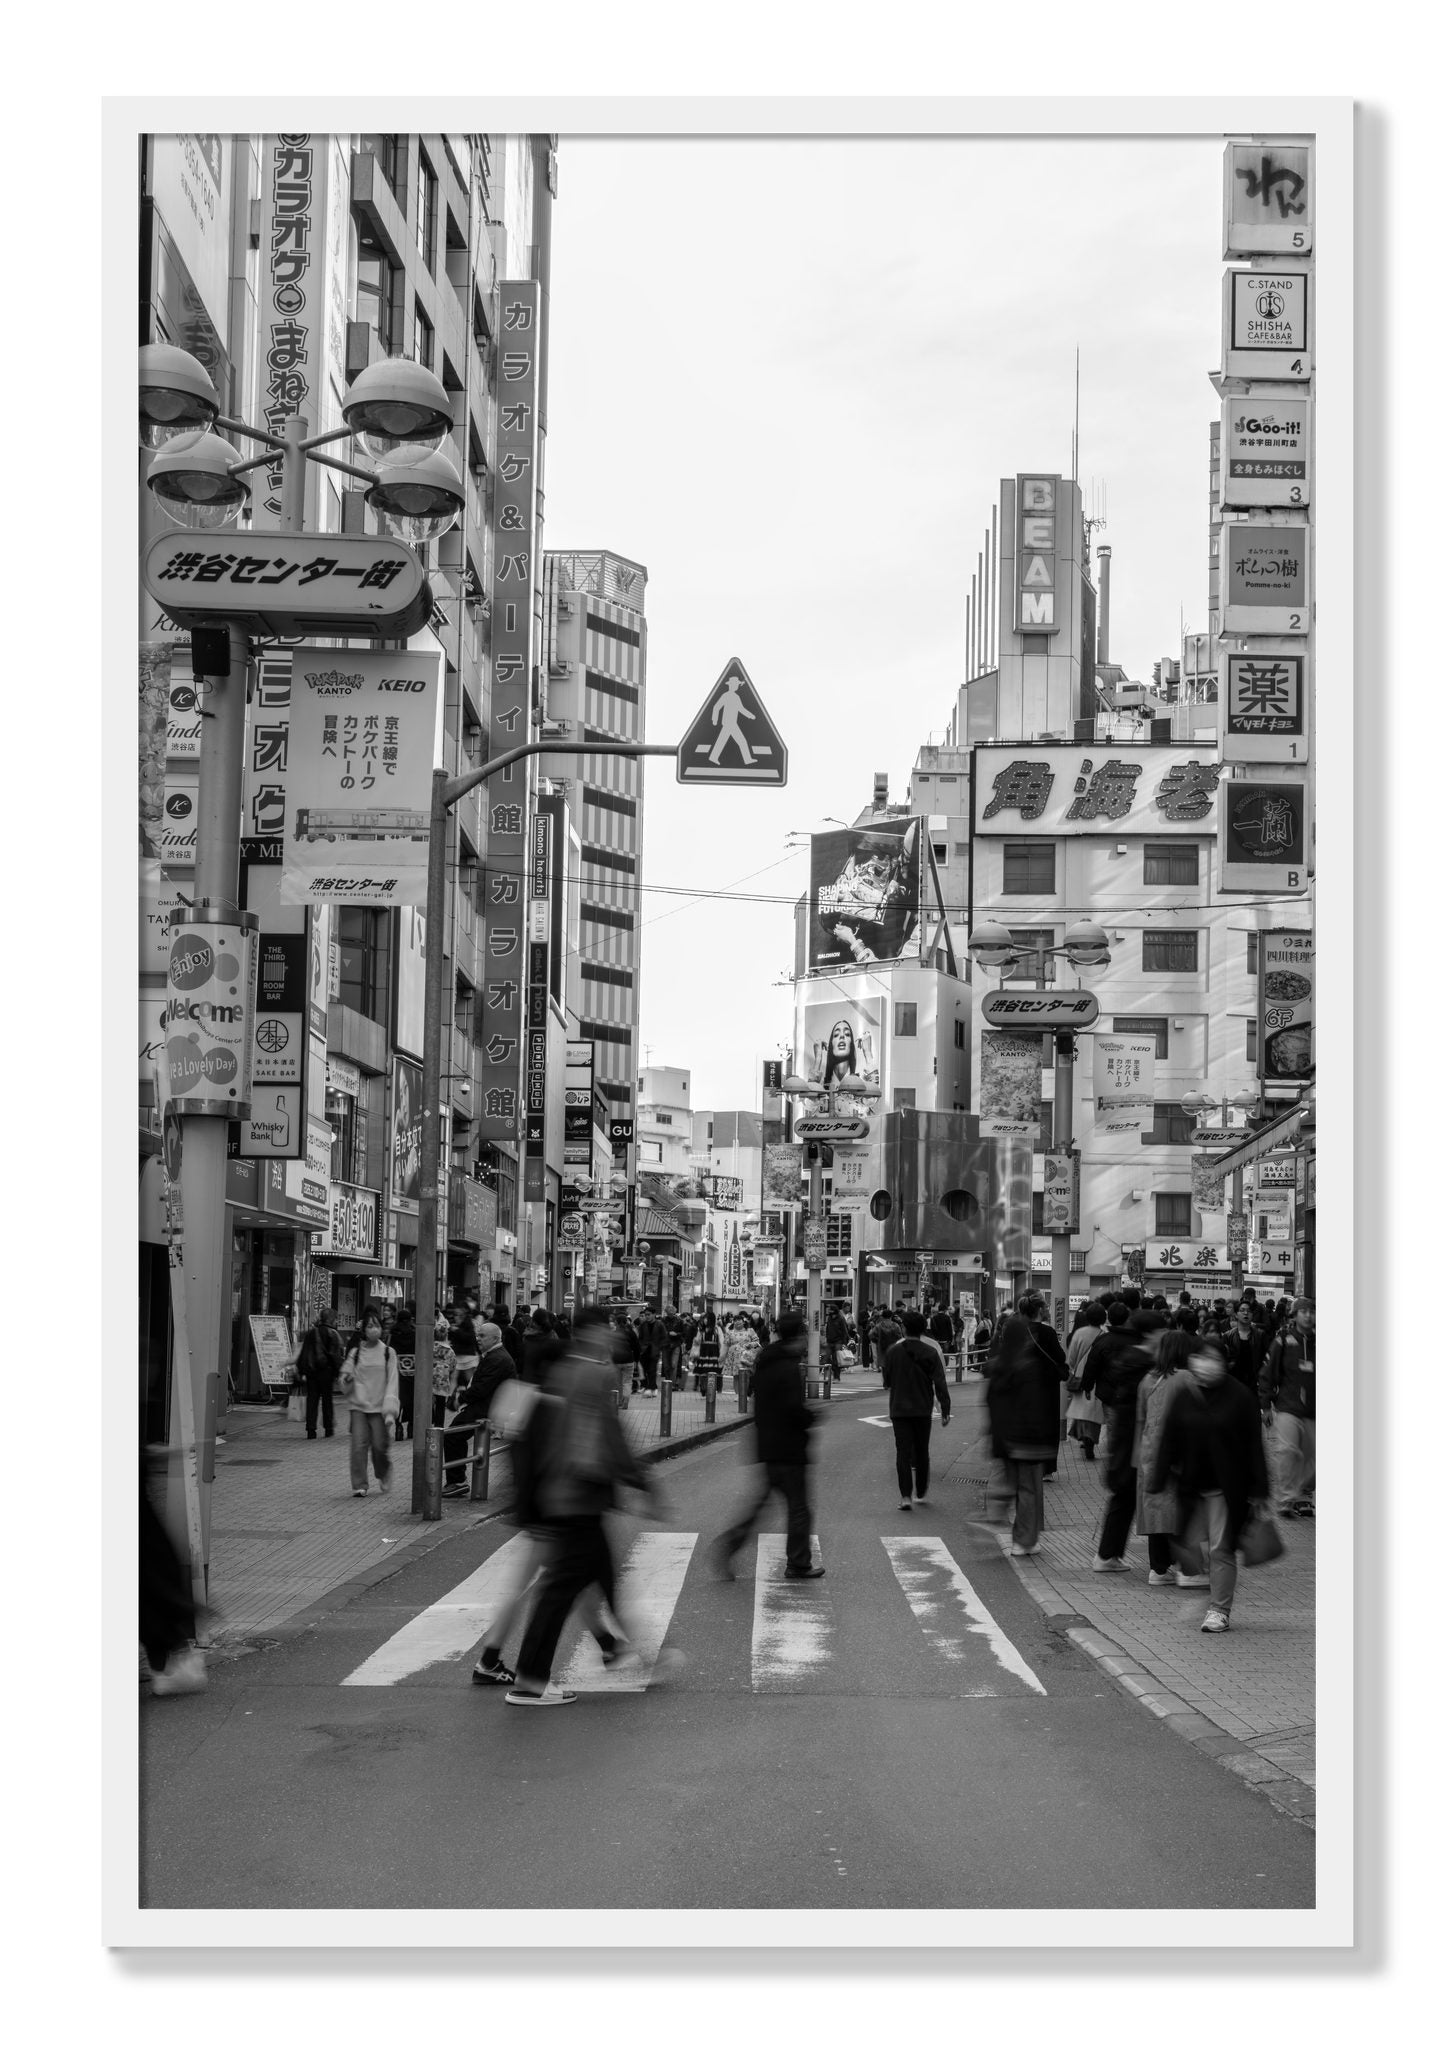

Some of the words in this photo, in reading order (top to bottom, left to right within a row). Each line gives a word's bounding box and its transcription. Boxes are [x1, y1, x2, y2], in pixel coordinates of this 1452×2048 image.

[272, 146, 314, 286] カラオケ
[1292, 232, 1304, 247] 5
[1248, 280, 1293, 289] C.STAND
[1248, 320, 1292, 331] SHISHA
[1248, 331, 1292, 340] CAFE&BAR
[1234, 463, 1302, 476] 全身もみほぐし
[1290, 486, 1302, 503] 3
[1023, 481, 1056, 625] BEAM
[158, 551, 408, 590] 渋谷センター街
[1246, 581, 1291, 589] Pomme-no-ki
[1289, 613, 1302, 630] 2
[317, 687, 352, 695] KANTO
[378, 679, 426, 693] KEIO
[1238, 662, 1289, 714] 薬
[1232, 716, 1295, 732] マツモトキヨシ
[322, 715, 338, 758] 冒険へ
[171, 742, 196, 751] 渋谷店
[340, 715, 358, 790] カントーの
[361, 715, 379, 790] ポケパーク
[382, 716, 399, 776] 京王線で
[1289, 742, 1298, 758] 1
[982, 760, 1223, 820] 角海老
[1233, 799, 1294, 847] 一蘭
[537, 819, 546, 854] kimono
[167, 850, 192, 859] 渋谷店
[309, 878, 398, 891] 渋谷センター街
[536, 860, 545, 894] hearts
[1288, 871, 1300, 887] B
[170, 947, 211, 983] Enjoy
[1267, 951, 1311, 963] 四川料理
[167, 997, 244, 1023] Welcome
[989, 1000, 1092, 1012] 渋谷センター街
[1265, 1009, 1294, 1028] 6F
[183, 1056, 214, 1076] Lovely
[216, 1057, 236, 1072] Day!
[577, 1096, 590, 1104] UP
[252, 1122, 285, 1133] Whisky
[612, 1126, 632, 1136] GU
[251, 1132, 271, 1140] Bank
[731, 1243, 741, 1286] BEER
